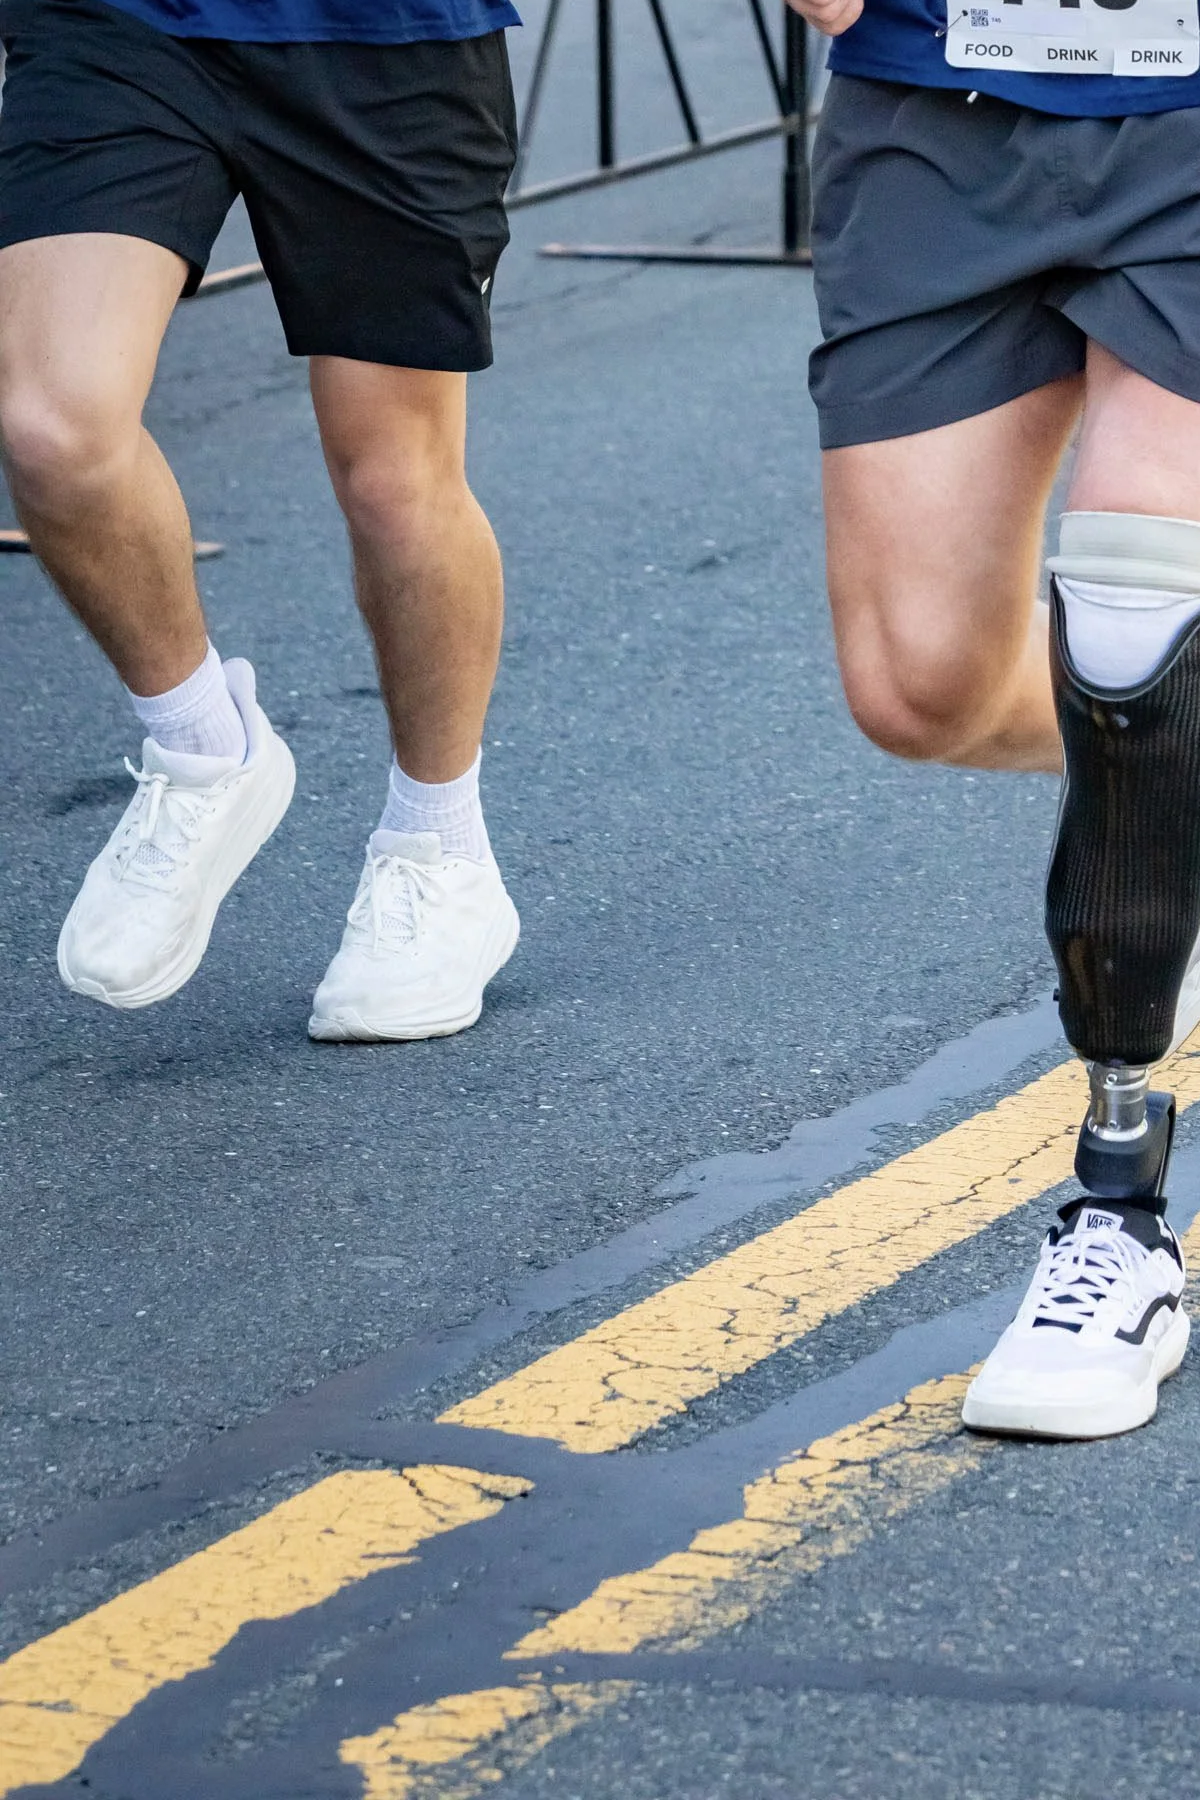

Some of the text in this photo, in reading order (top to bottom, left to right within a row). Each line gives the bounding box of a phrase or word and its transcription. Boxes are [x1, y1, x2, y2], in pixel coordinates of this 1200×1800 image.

[964, 44, 1183, 63] FOOD DRINK DRINK
